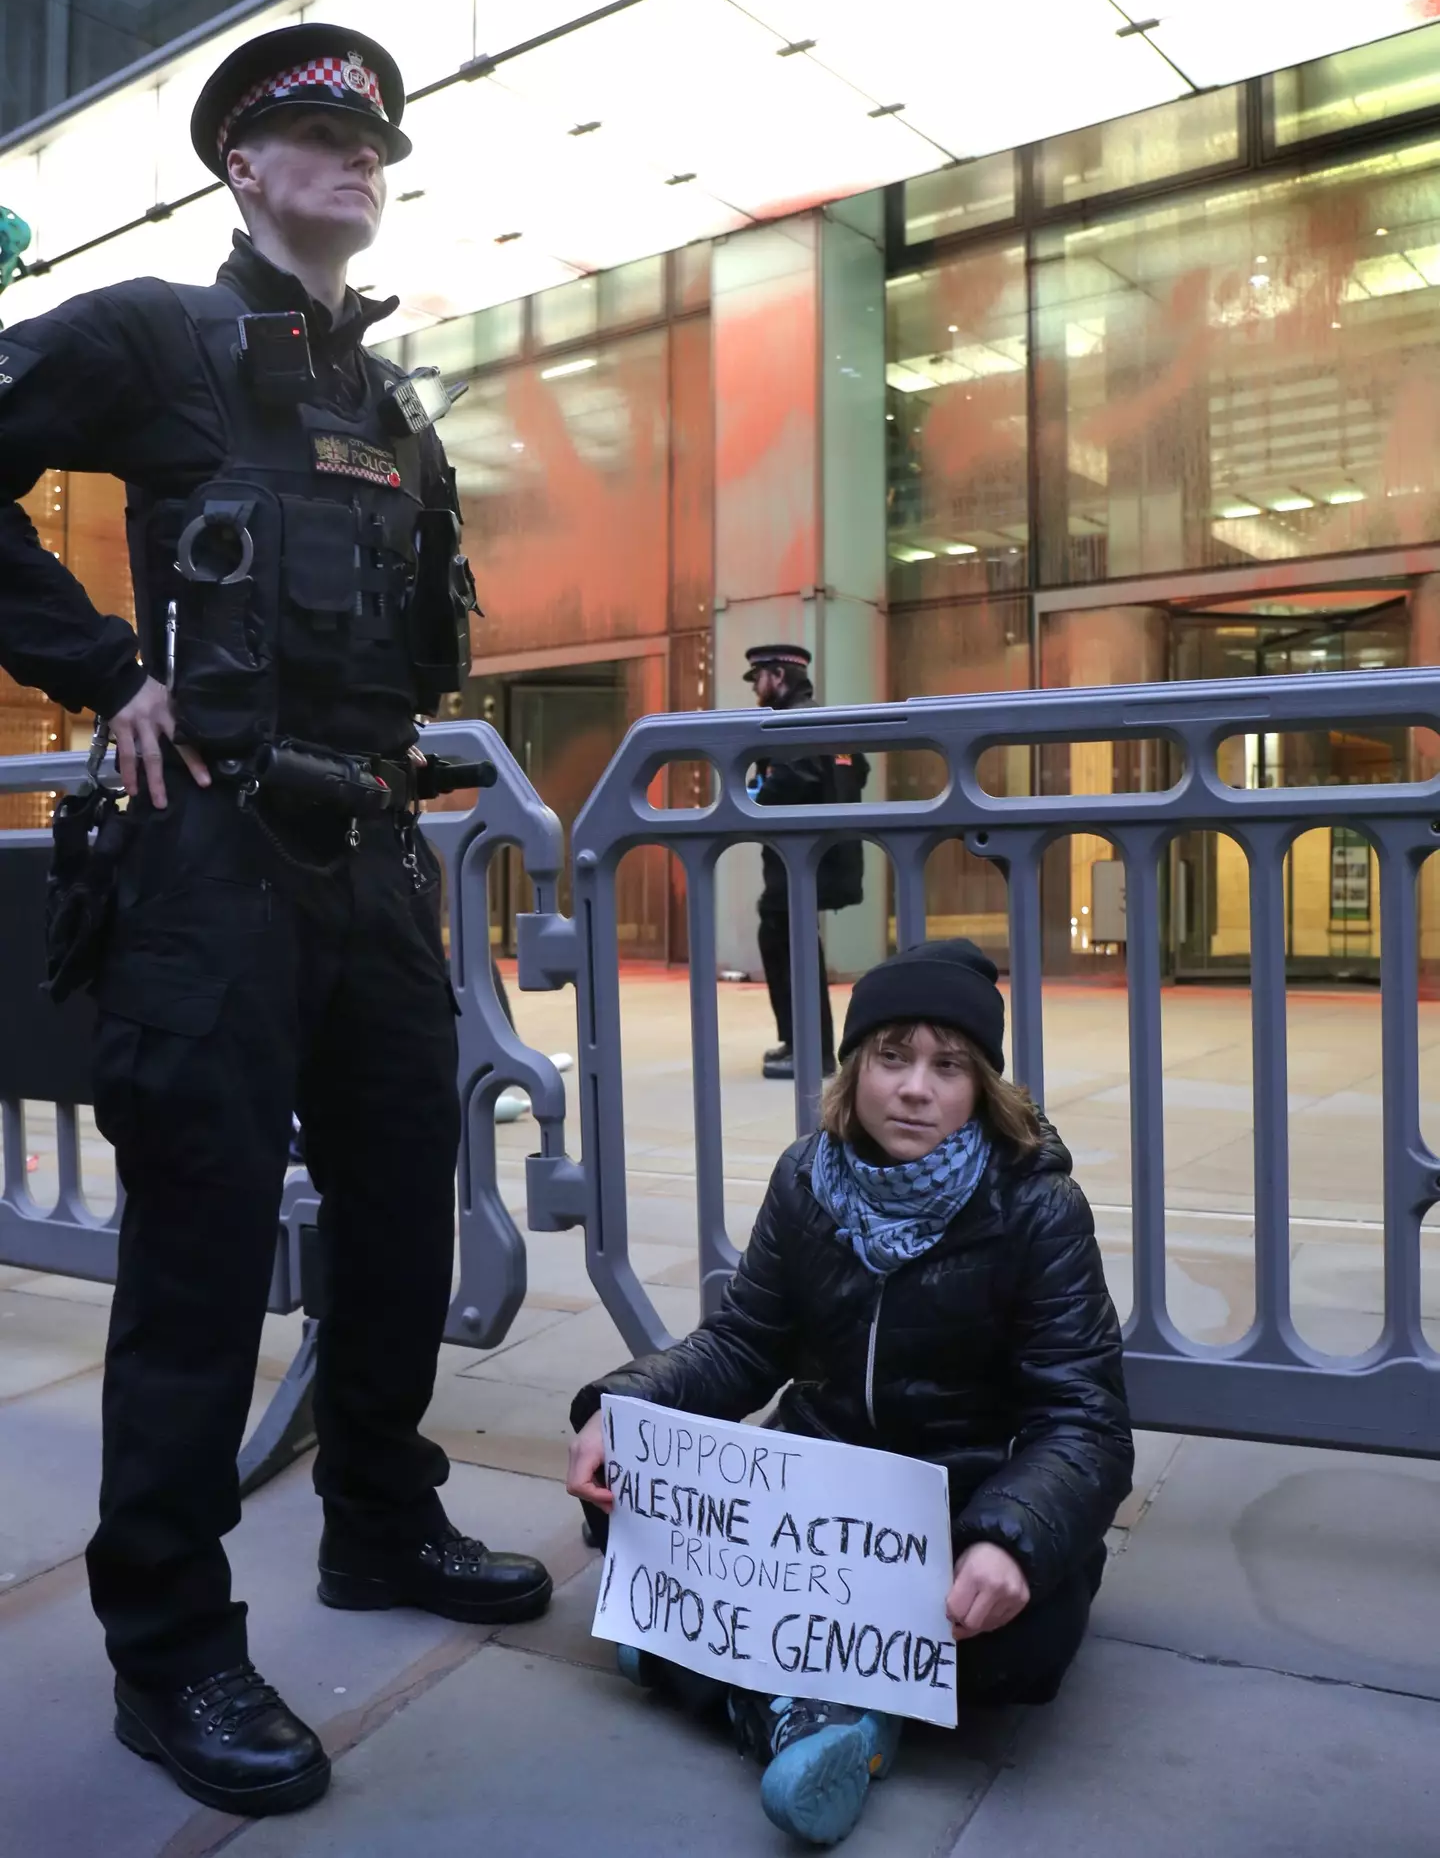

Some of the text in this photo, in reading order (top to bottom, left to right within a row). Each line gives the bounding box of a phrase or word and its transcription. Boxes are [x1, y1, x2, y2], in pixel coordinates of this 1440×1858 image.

[604, 1406, 802, 1492] I SUPPORT
[606, 1460, 928, 1567] PALESTINE ACTION
[669, 1529, 853, 1605] PRISONERS
[629, 1564, 752, 1661] OPPOSE
[771, 1613, 957, 1690] GENOCIDE
